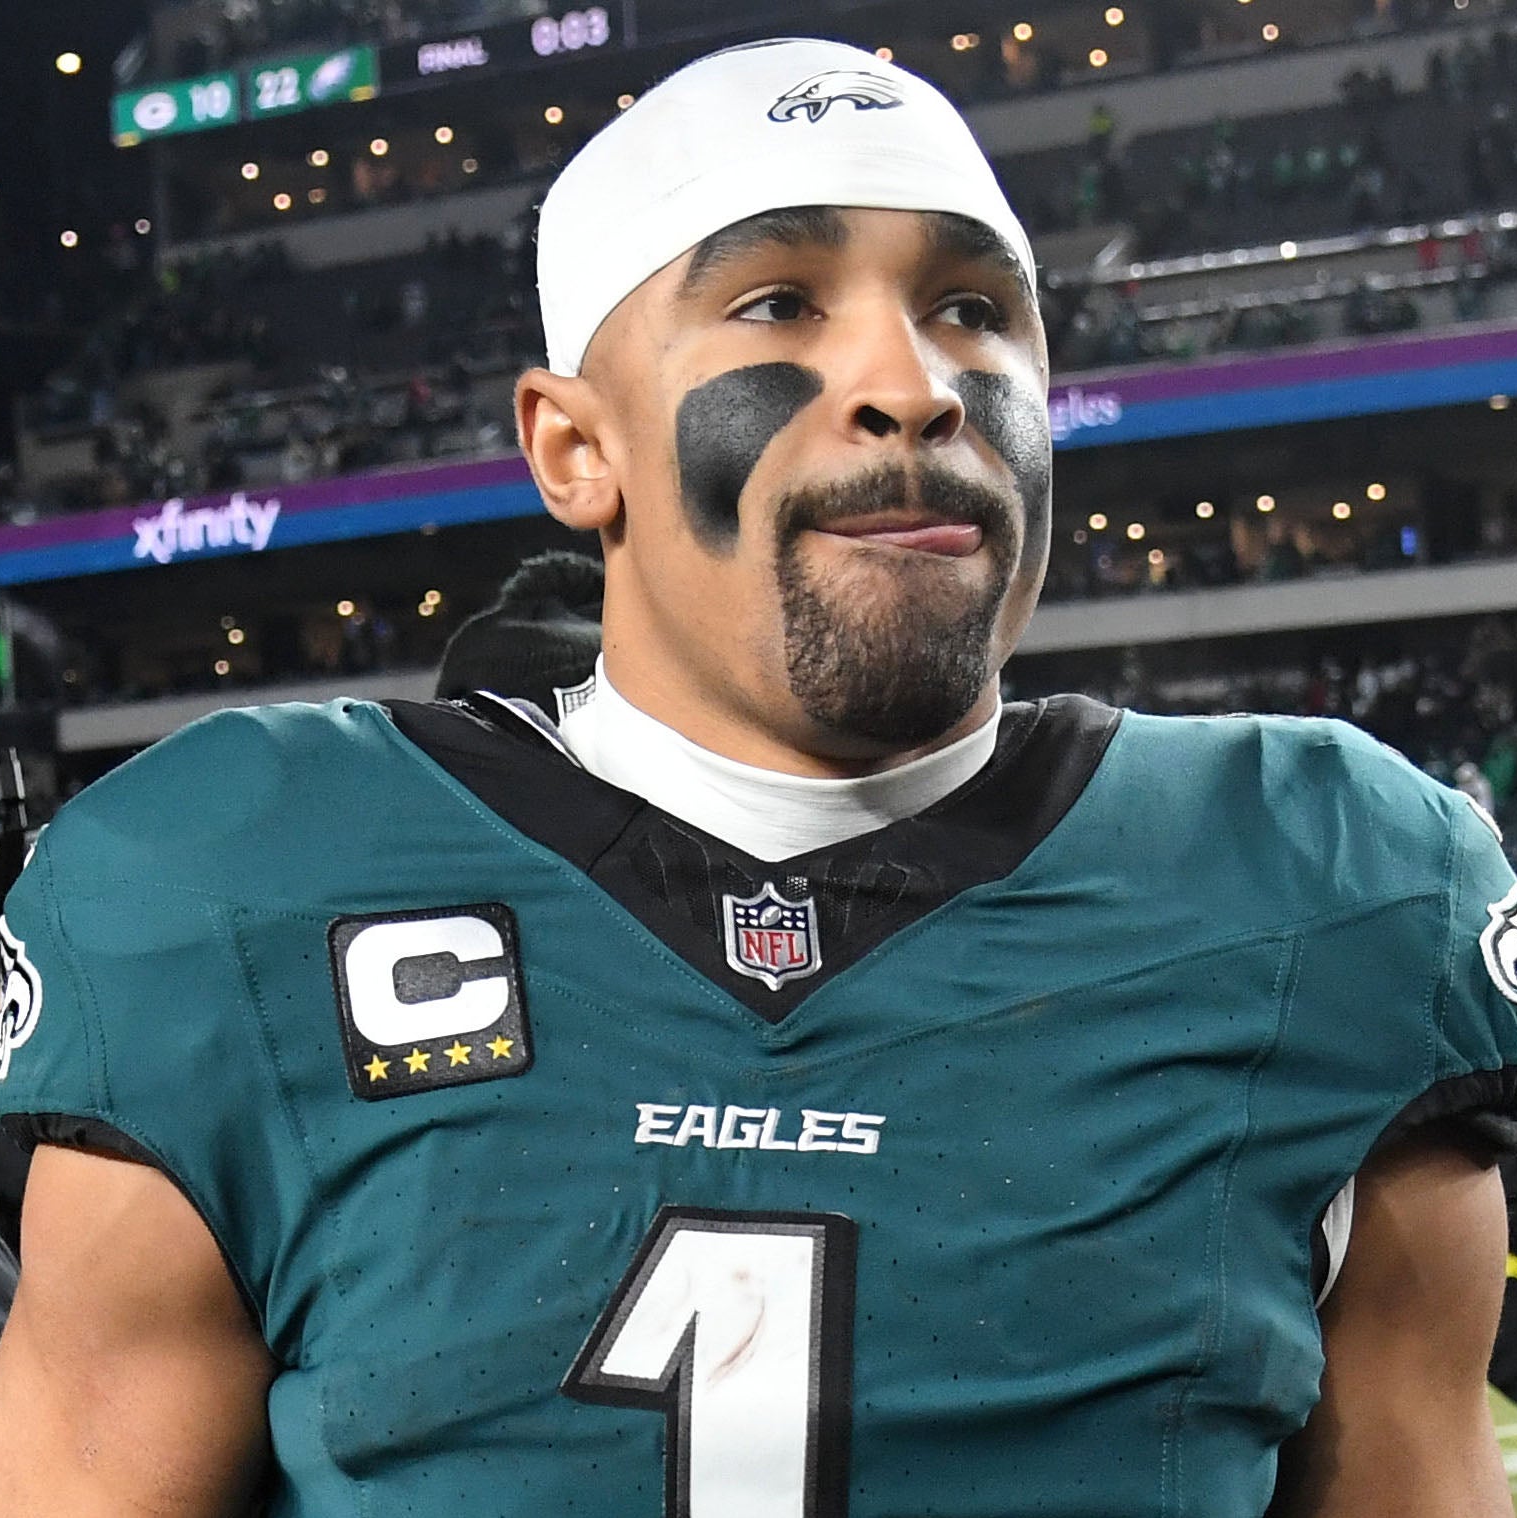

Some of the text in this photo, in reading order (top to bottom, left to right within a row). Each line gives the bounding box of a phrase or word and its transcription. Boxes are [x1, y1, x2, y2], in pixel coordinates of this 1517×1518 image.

[256, 67, 300, 108] 22
[133, 495, 281, 563] xfinity
[743, 931, 805, 967] NFL
[346, 916, 509, 1046] C
[634, 1103, 886, 1154] EAGLES
